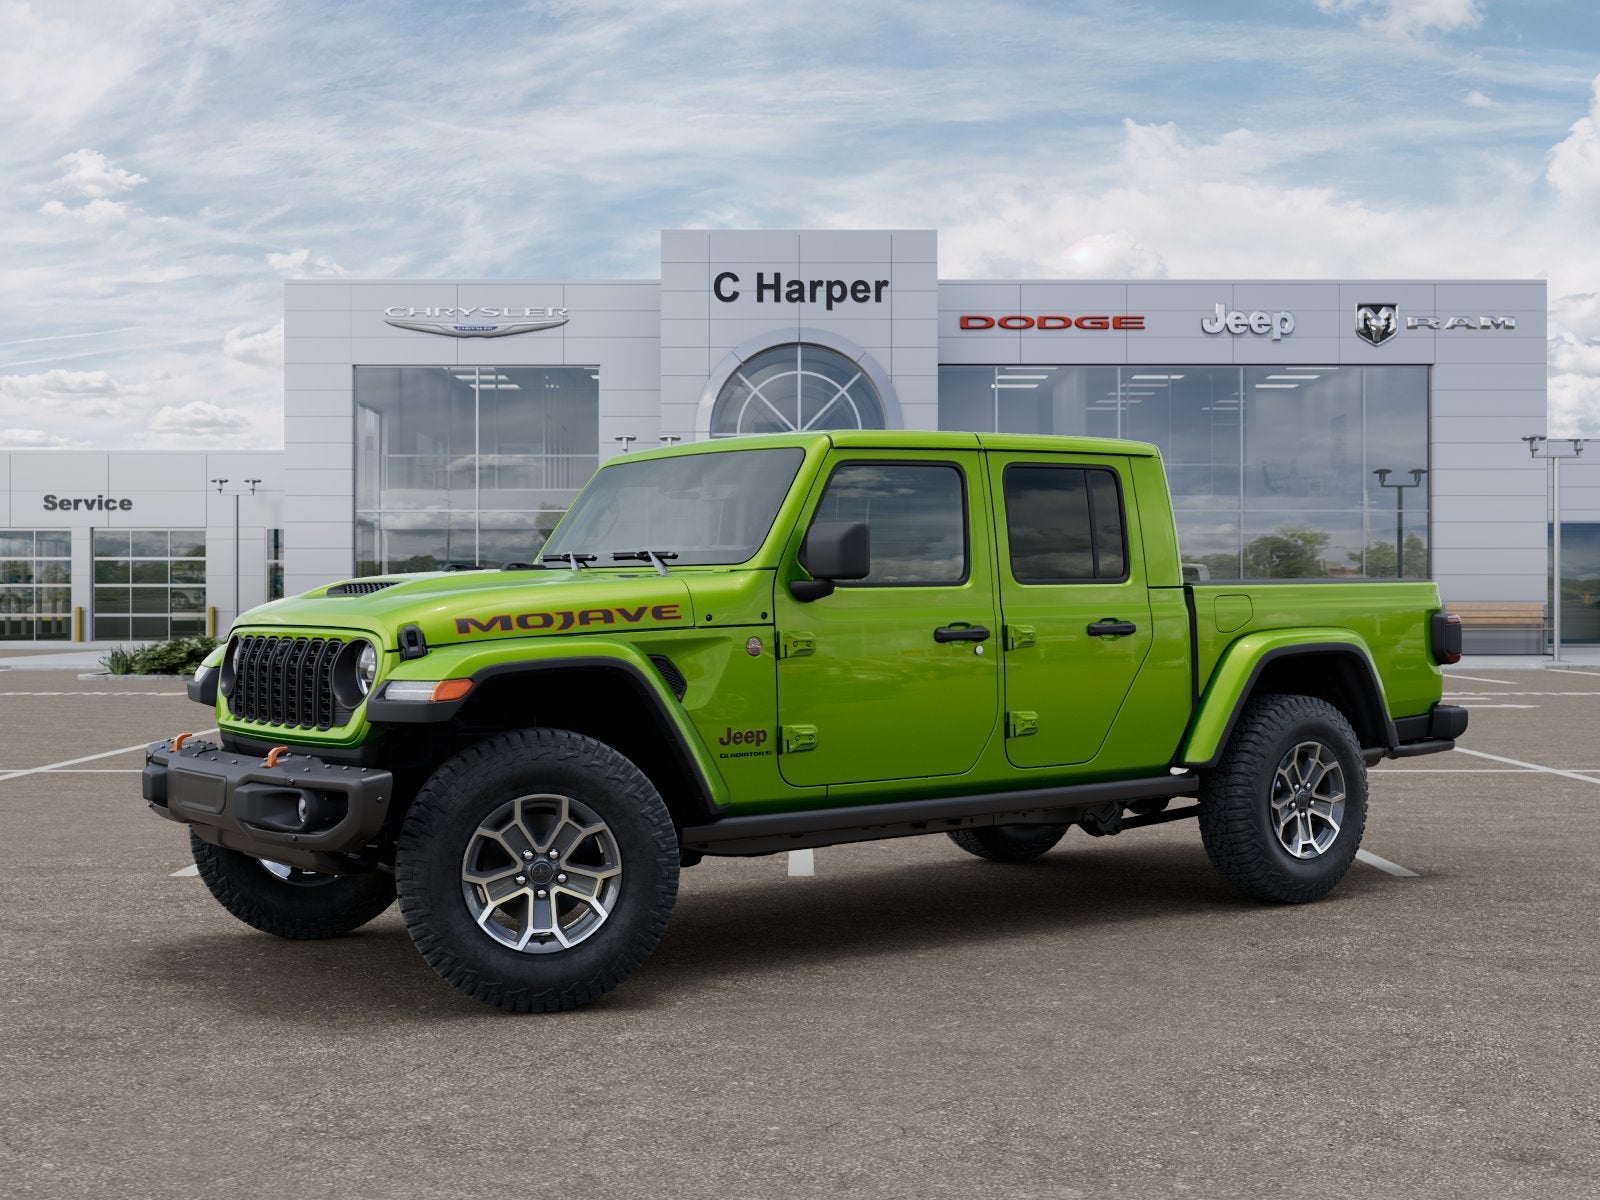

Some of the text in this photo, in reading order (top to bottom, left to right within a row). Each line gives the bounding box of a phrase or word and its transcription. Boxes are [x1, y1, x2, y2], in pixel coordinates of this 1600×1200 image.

[713, 271, 890, 310] C Harper
[385, 306, 570, 317] CHRYSLER
[959, 315, 1145, 330] DODGE
[1201, 303, 1295, 343] Jeep
[1406, 316, 1516, 330] RAM
[43, 494, 133, 511] Service
[455, 604, 682, 635] MOJAVE
[718, 727, 768, 747] Jeep
[720, 751, 764, 759] GLADIATOR
